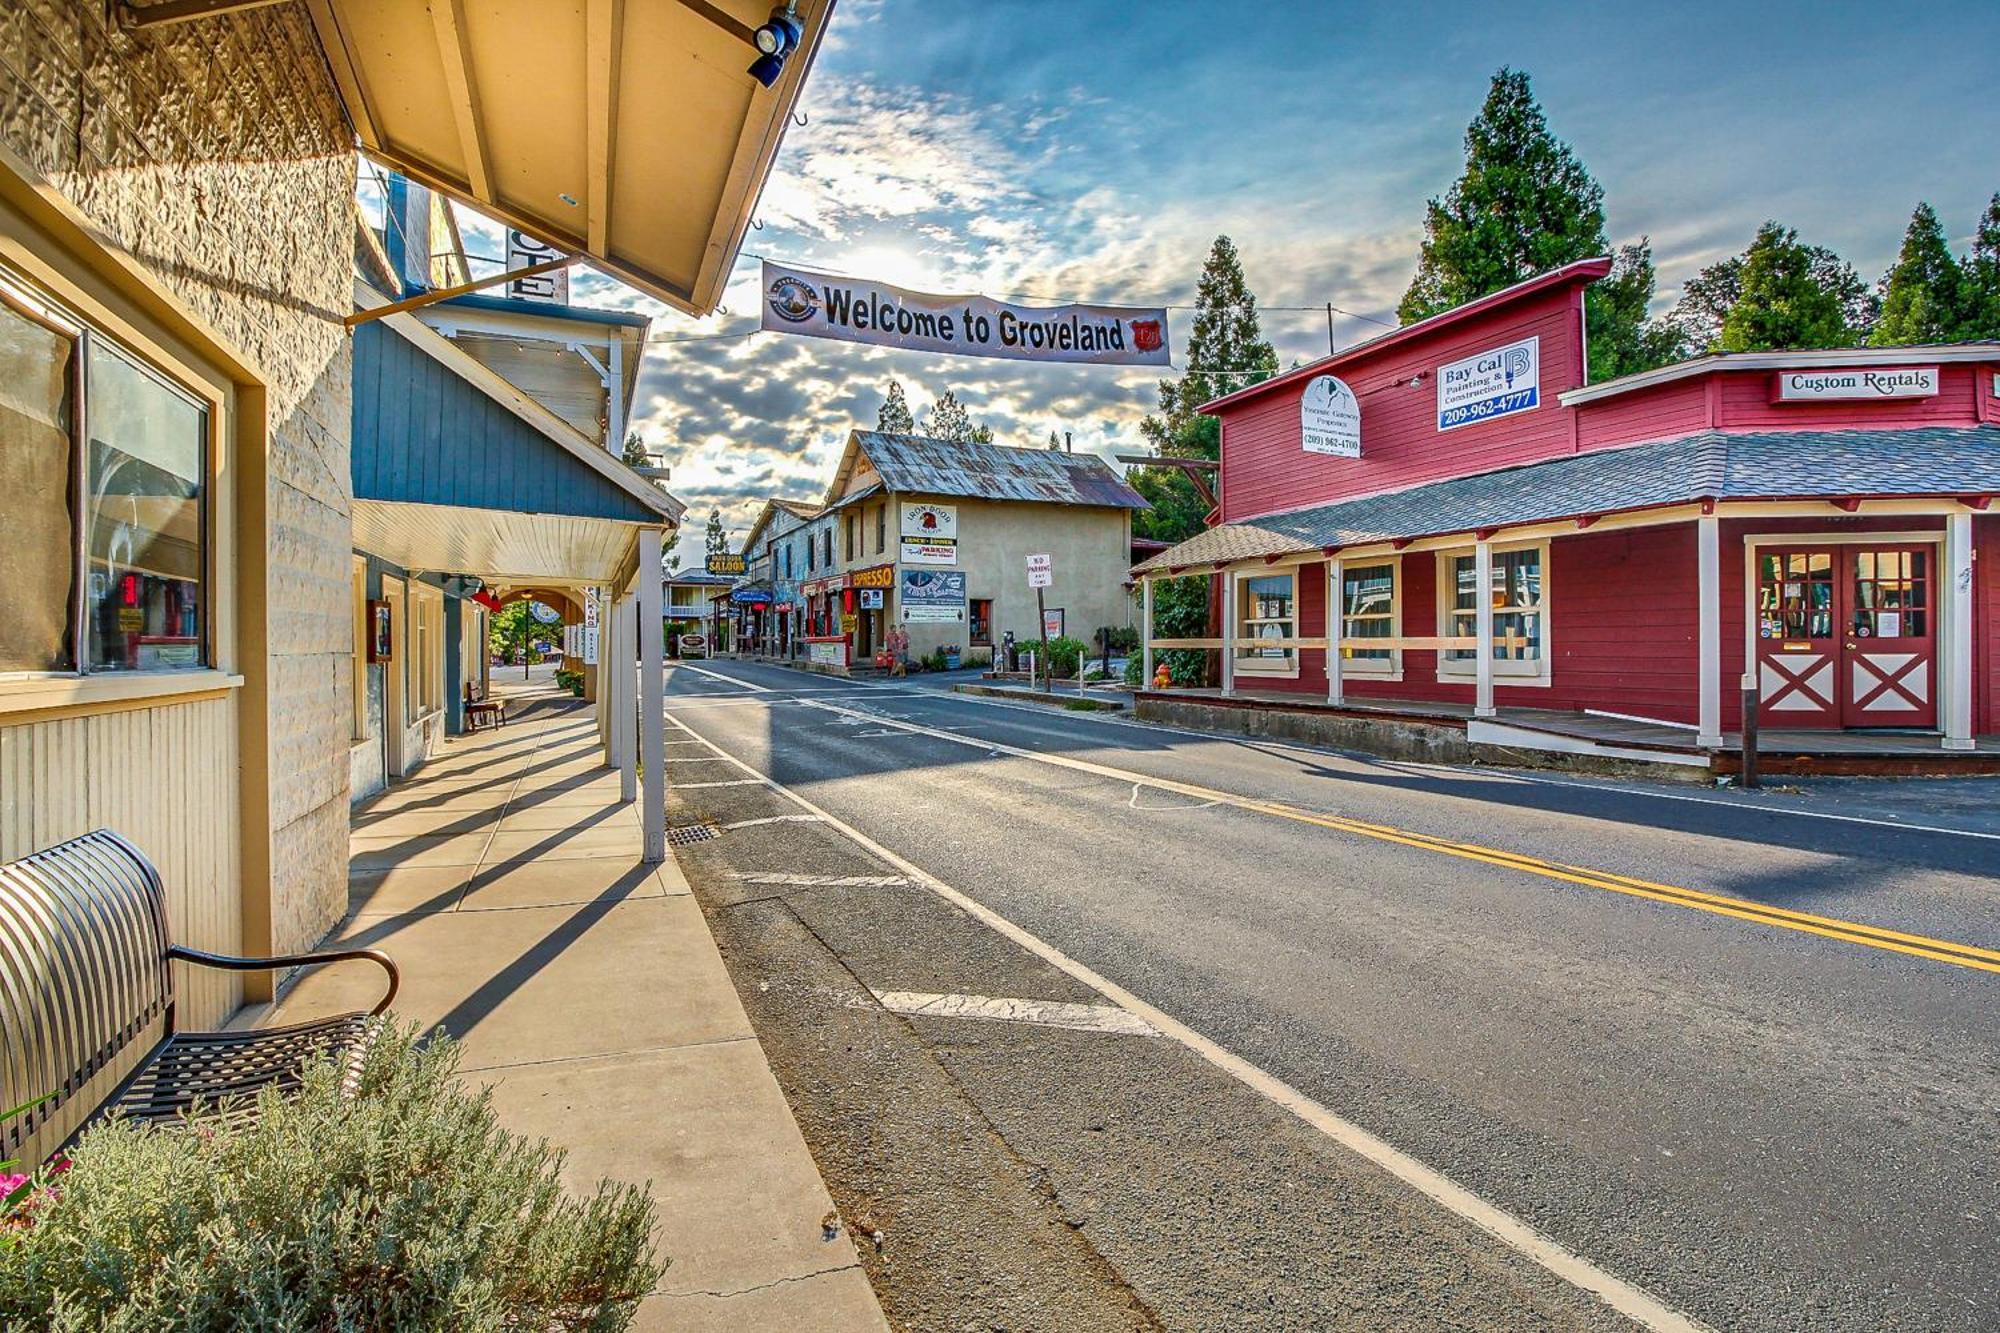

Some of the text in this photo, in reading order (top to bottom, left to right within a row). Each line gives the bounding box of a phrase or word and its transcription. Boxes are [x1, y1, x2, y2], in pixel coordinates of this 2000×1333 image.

[824, 286, 955, 341] Welcome
[963, 307, 990, 343] to
[998, 309, 1126, 352] Groveland
[1445, 354, 1503, 389] Bay Cal
[1791, 371, 1931, 395] Custom Rentals
[1444, 383, 1504, 405] Construction
[1445, 372, 1503, 402] Painting &
[1445, 391, 1531, 425] 209-962-4777
[1303, 434, 1359, 450] (209) 962-4700
[907, 505, 952, 523] IRON DOOR
[708, 560, 746, 572] SALOON
[853, 567, 892, 587] ESPRESSO
